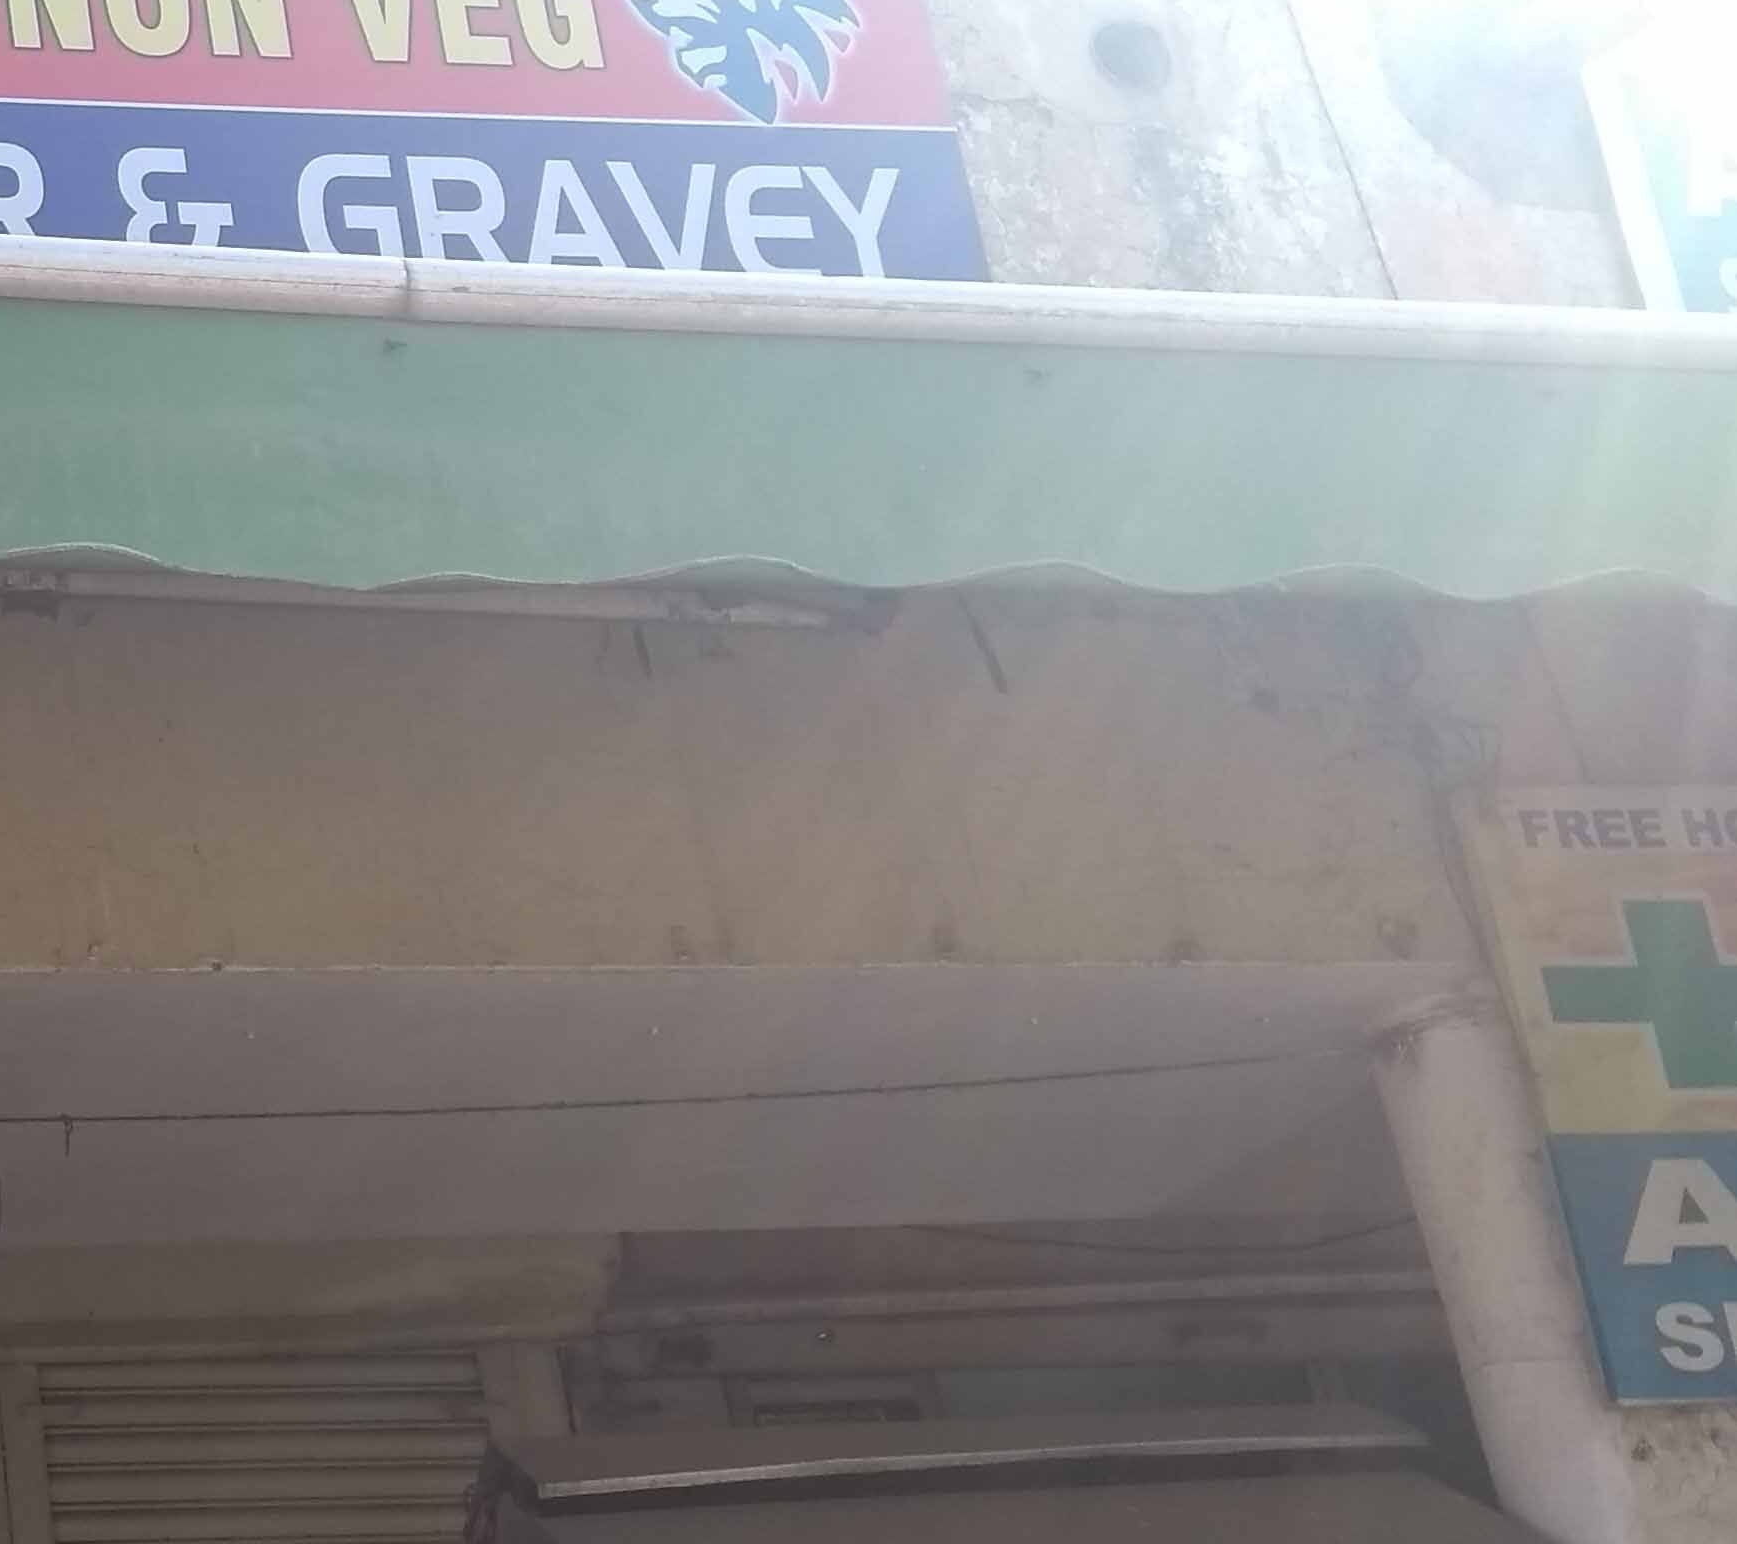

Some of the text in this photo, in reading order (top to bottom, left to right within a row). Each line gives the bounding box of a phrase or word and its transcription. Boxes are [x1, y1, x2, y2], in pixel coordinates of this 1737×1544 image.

[116, 145, 236, 246] &
[295, 151, 901, 277] GRAVEY
[1518, 808, 1667, 849] FREE
